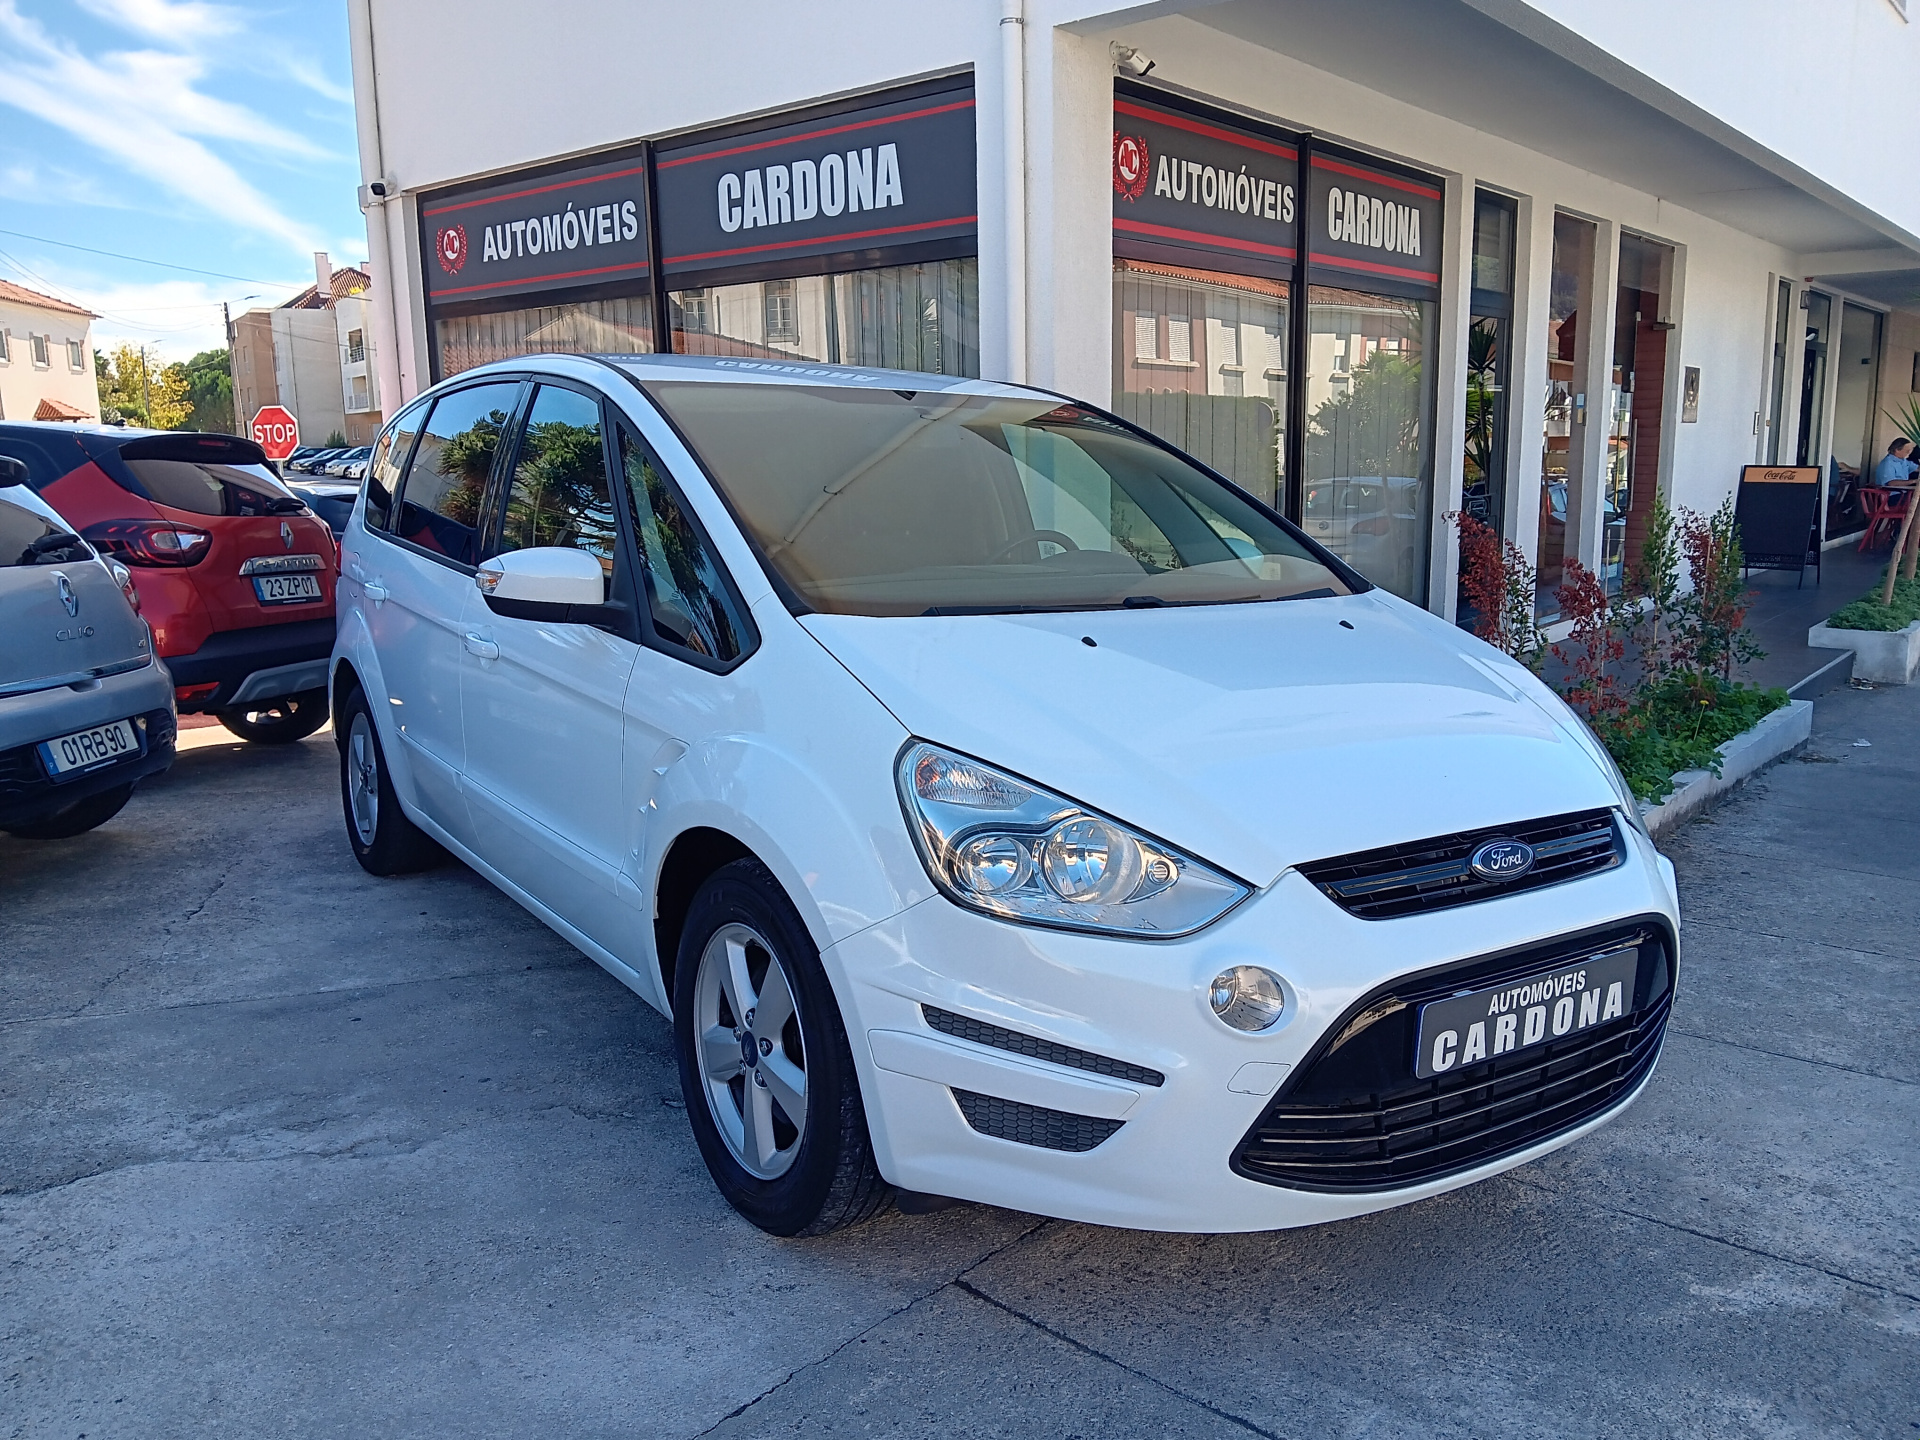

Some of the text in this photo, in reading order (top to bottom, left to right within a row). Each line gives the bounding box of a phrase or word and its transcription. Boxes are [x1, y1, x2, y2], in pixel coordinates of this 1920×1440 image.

[483, 200, 638, 262] AUTOMÓVEIS
[717, 143, 904, 233] CARDONA
[1154, 154, 1295, 224] AUTOMÓVEIS
[1328, 186, 1421, 257] CARDONA
[254, 423, 296, 444] STOP
[56, 625, 95, 642] CLIO
[1491, 846, 1524, 869] Ford
[1487, 970, 1586, 1017] AUTOMÓVEIS
[1432, 981, 1623, 1073] CARDONA
